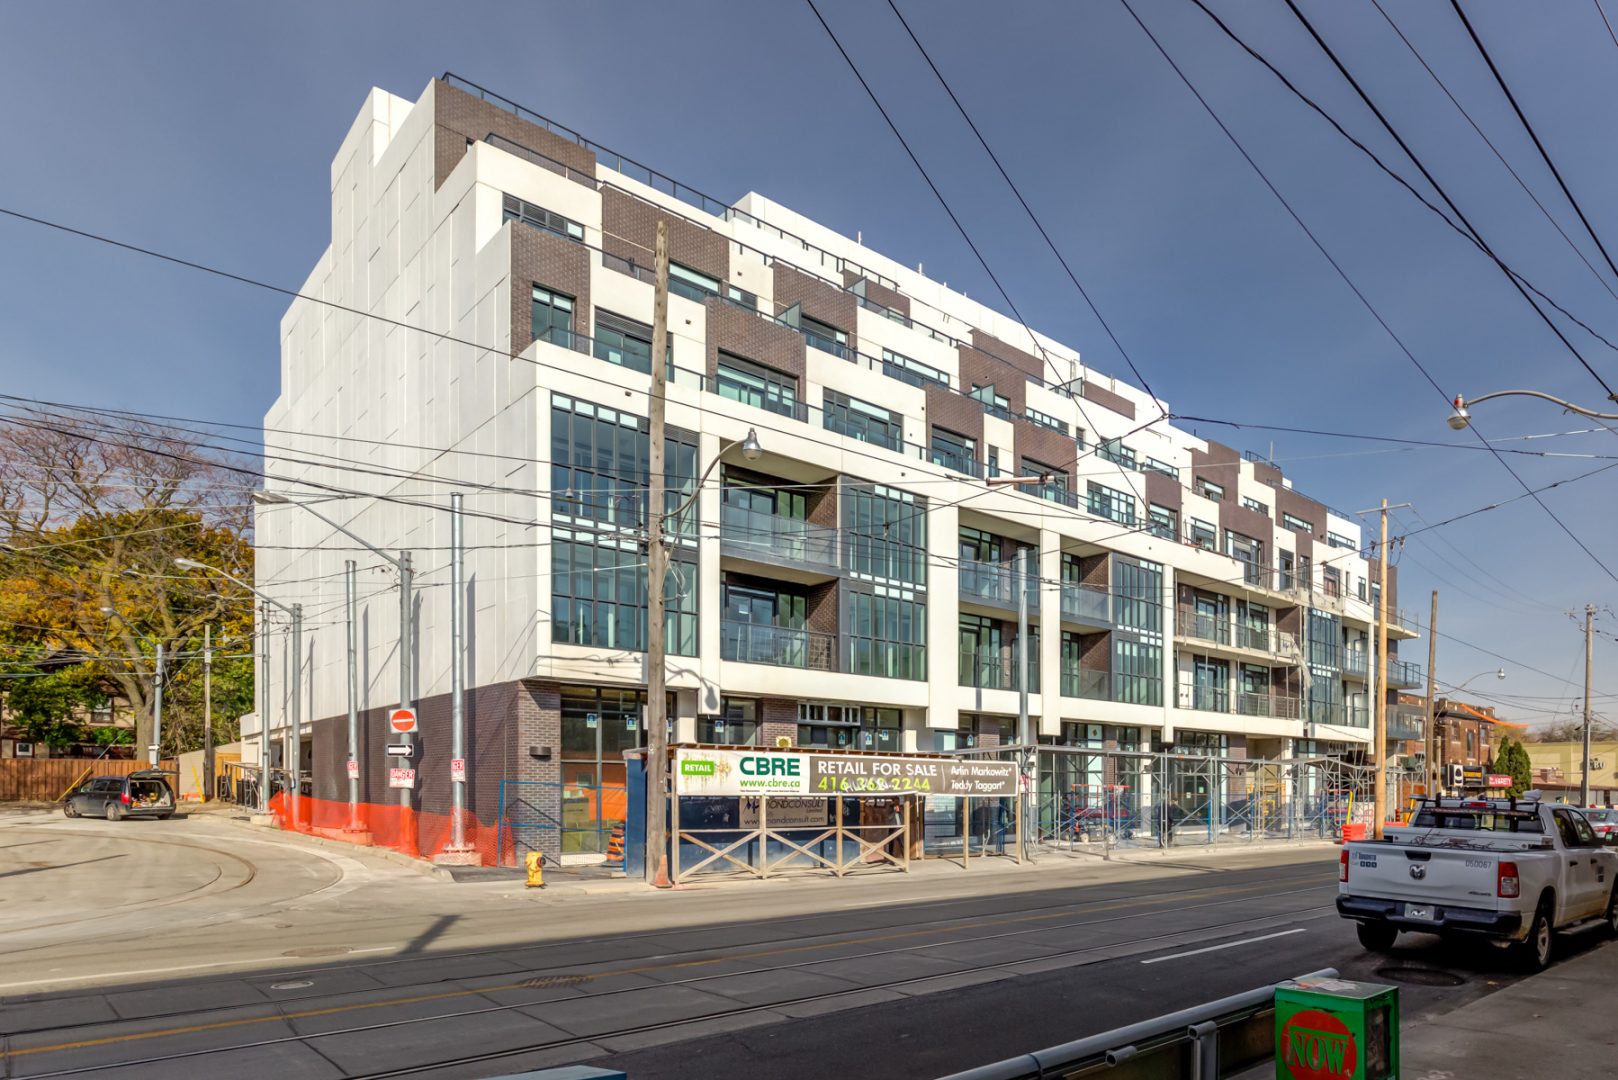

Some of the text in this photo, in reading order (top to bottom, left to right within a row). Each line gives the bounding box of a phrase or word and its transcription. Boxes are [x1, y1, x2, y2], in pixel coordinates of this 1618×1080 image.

[684, 763, 711, 773] RETAIL
[739, 756, 800, 776] CBRE
[818, 761, 938, 777] RETAIL FOR SALE
[950, 765, 970, 776] Arlin
[739, 778, 800, 788] www.cbre.ca
[951, 779, 973, 792] Teddy
[1288, 1031, 1348, 1076] NOW
